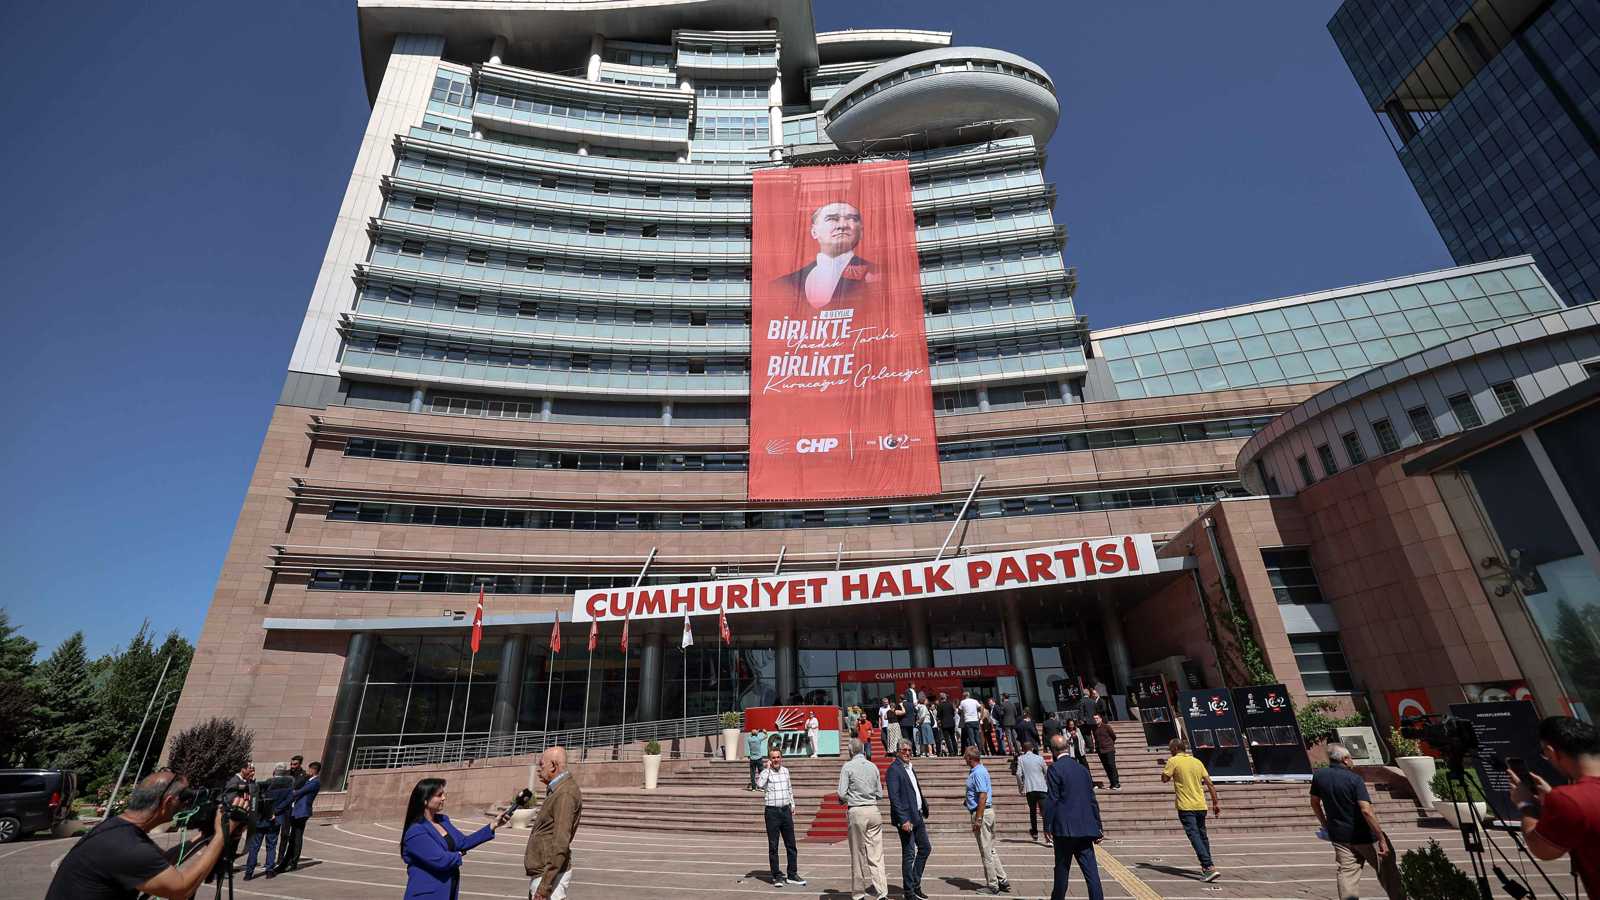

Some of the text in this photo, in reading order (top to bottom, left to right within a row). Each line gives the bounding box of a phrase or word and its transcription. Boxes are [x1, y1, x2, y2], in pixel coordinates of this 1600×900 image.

[767, 315, 853, 340] BİRLİKTE
[767, 351, 854, 377] BİRLİKTE
[796, 437, 839, 454] CHP
[586, 536, 1140, 617] CUMHURİYET HALK PARTİSİ
[875, 670, 925, 680] CUMHURİYET
[950, 668, 981, 677] PARTİSİ
